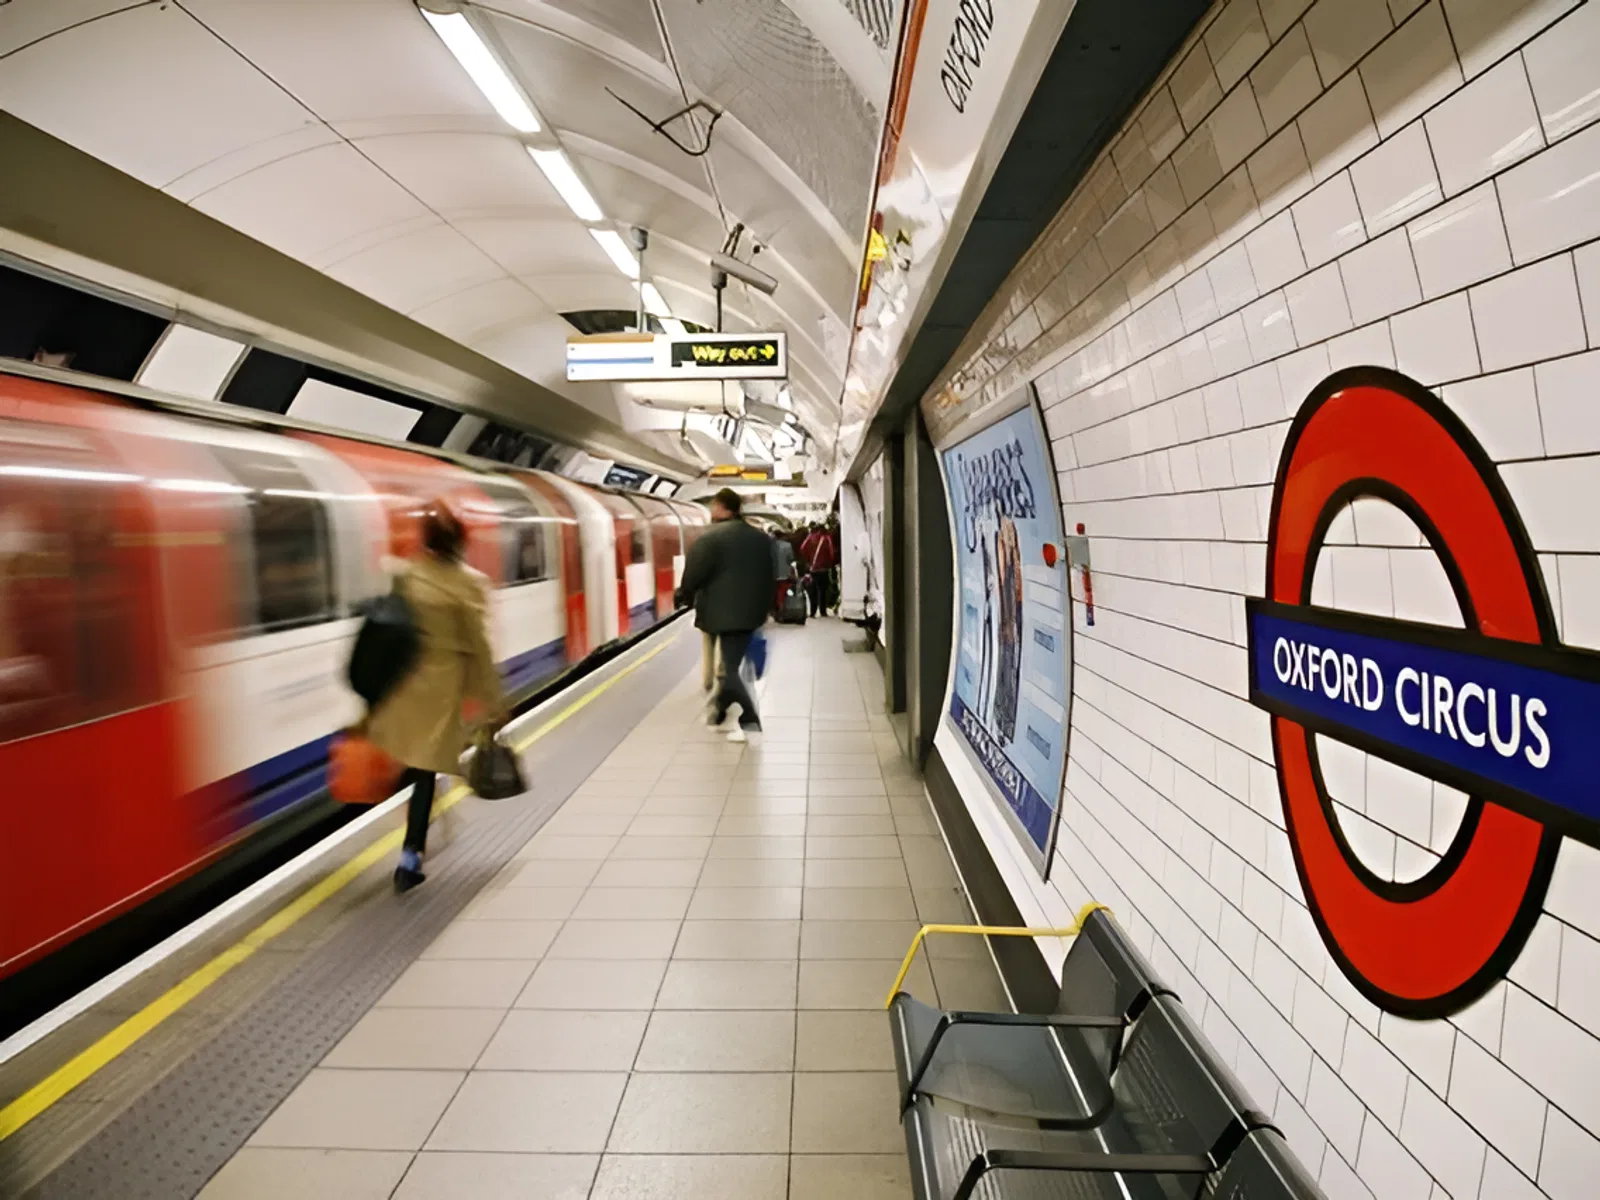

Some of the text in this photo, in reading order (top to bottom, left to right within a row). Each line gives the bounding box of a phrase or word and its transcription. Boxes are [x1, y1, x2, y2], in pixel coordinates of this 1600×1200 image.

[941, 0, 993, 113] OXFORD
[1273, 636, 1551, 769] OXFORD CIRCUS
